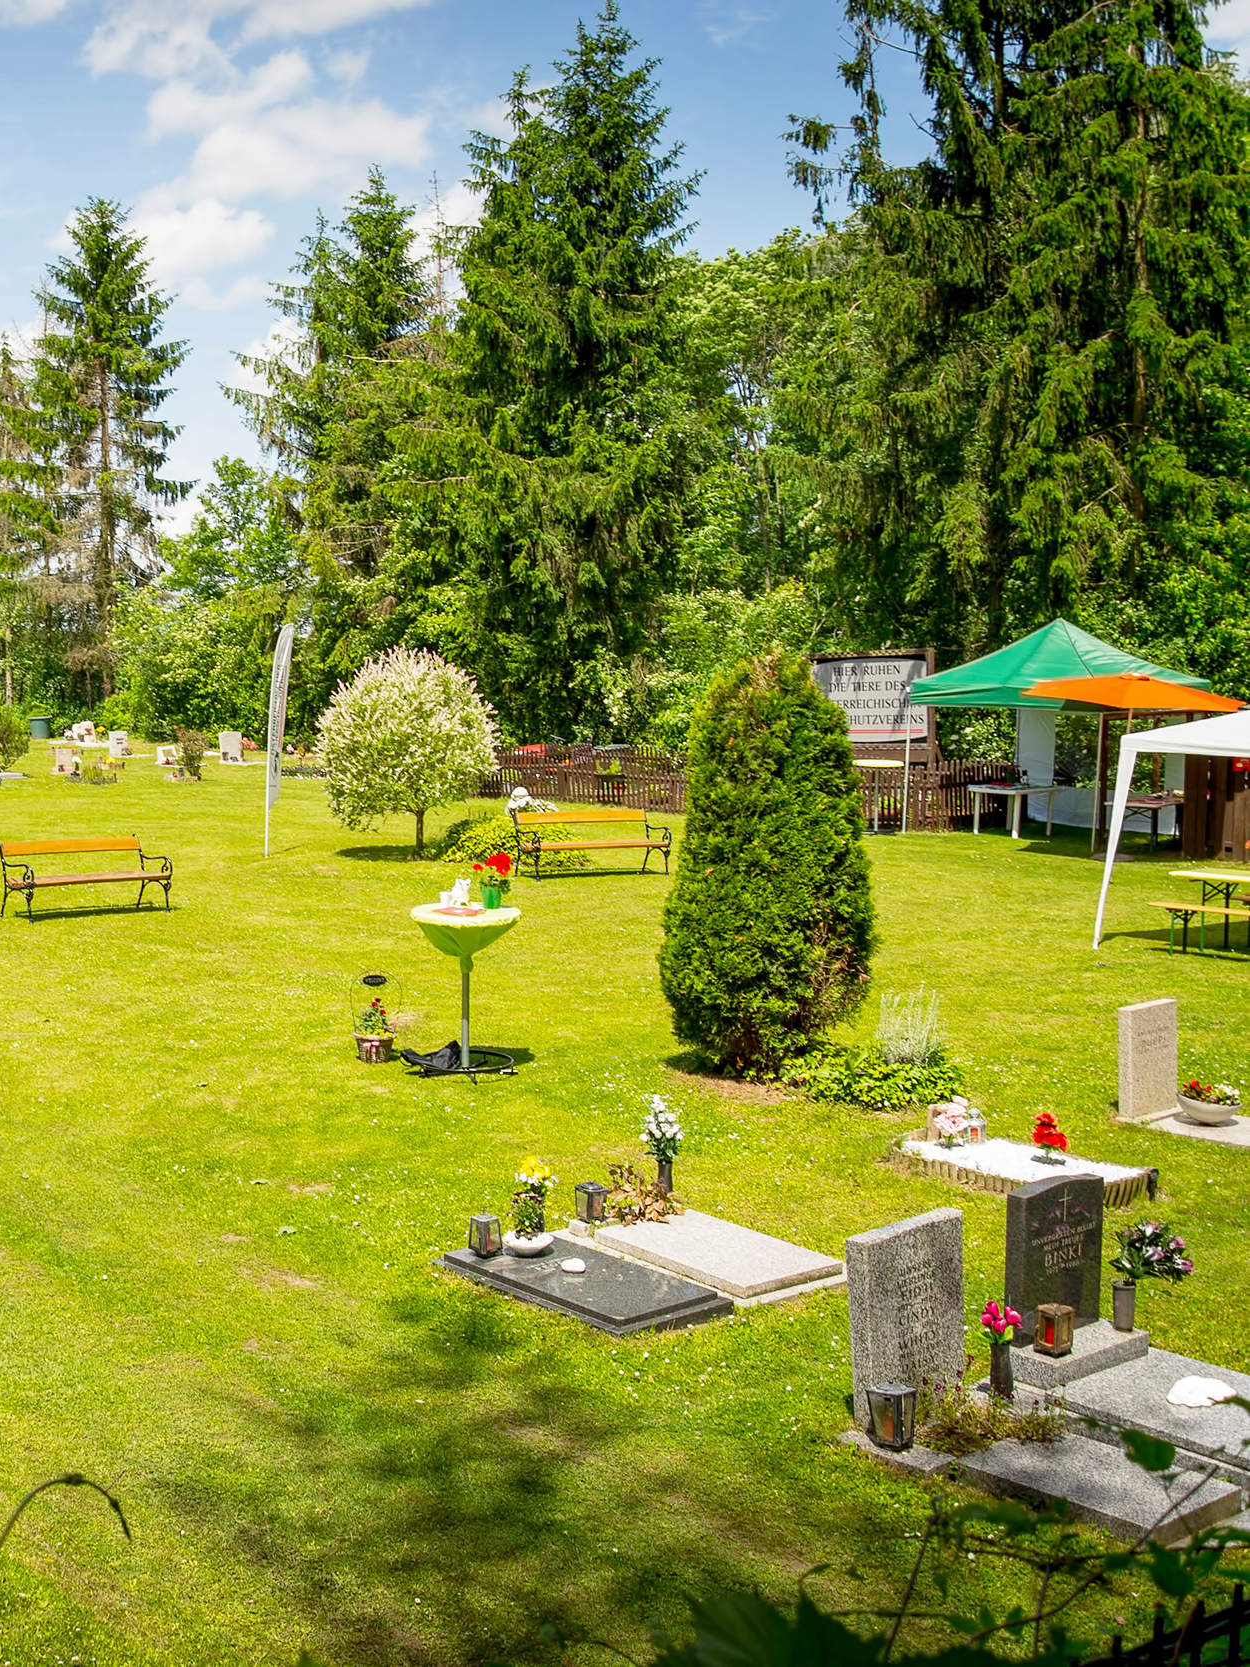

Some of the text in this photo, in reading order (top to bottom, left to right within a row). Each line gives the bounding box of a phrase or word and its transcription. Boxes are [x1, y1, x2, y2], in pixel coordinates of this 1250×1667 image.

[833, 665, 901, 676] HIER RUHEN
[829, 681, 906, 692] DIE TIERE DES
[847, 714, 925, 725] HUTZVEREINS
[1045, 1243, 1081, 1267] BINKI
[899, 1305, 934, 1326] CINDY
